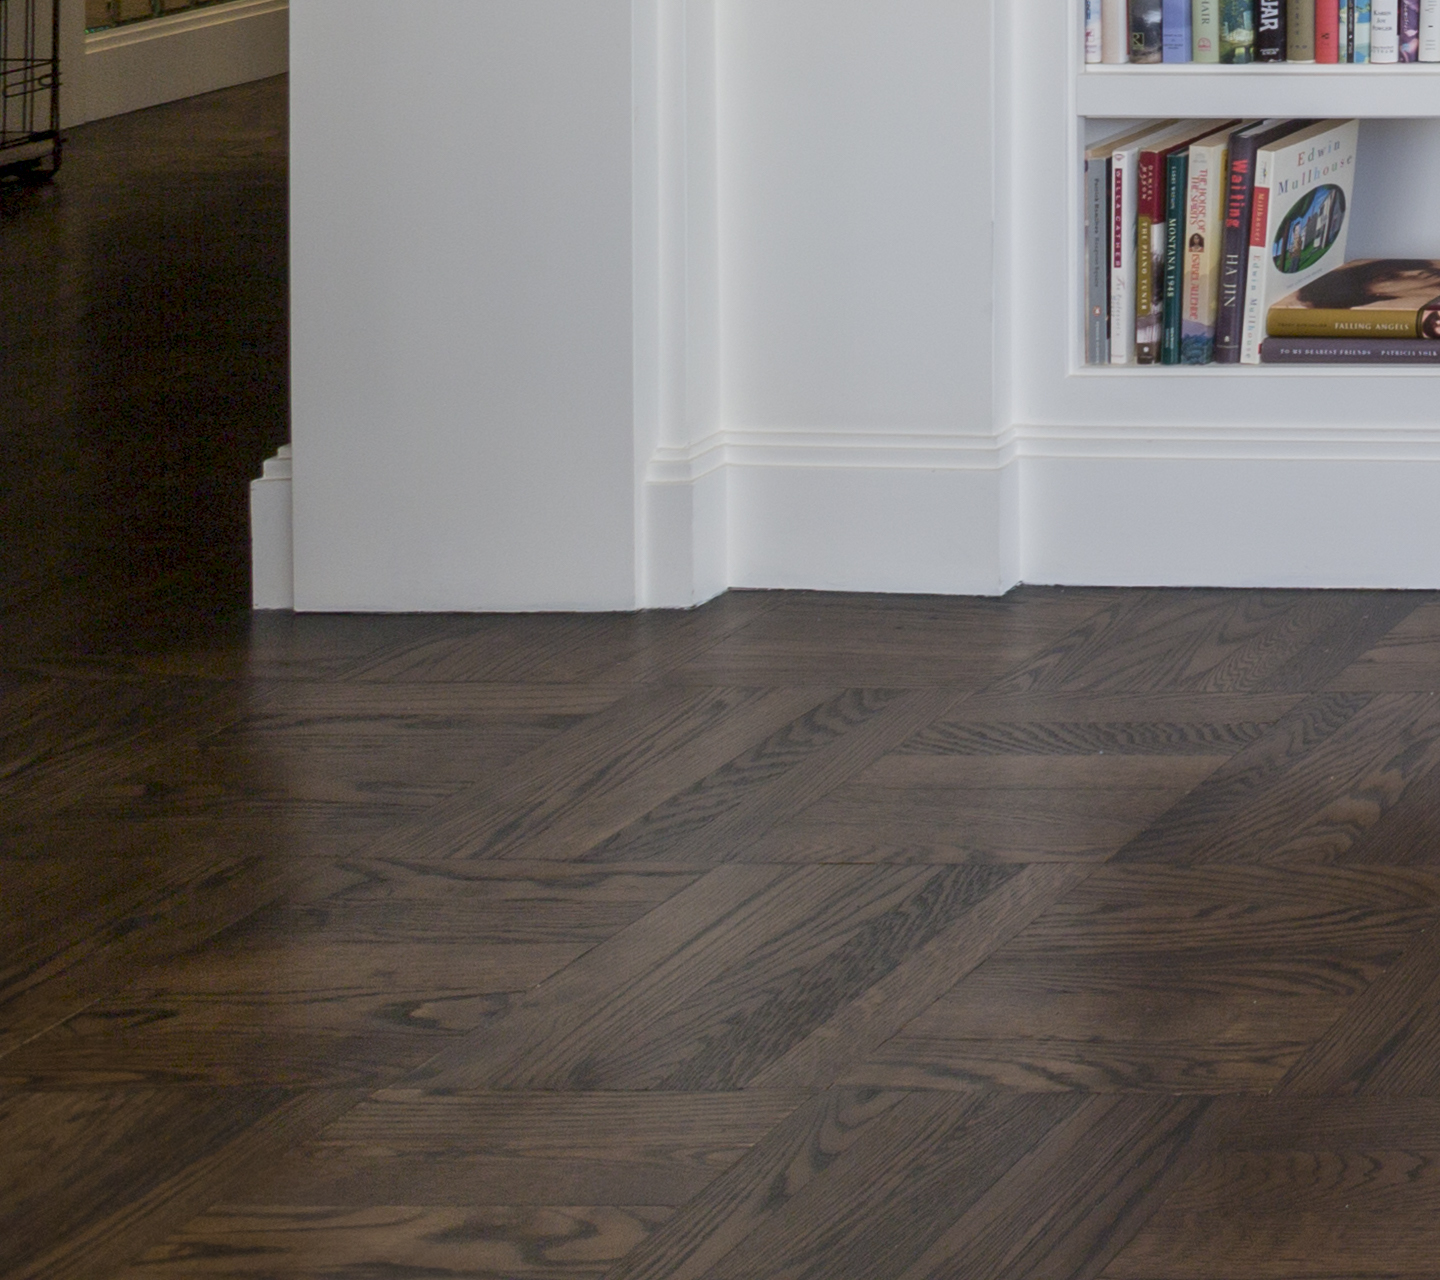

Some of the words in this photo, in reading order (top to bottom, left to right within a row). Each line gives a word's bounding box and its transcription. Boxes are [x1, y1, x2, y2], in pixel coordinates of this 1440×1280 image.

[1227, 160, 1247, 227] Waiting
[1225, 254, 1240, 275] HA
[1224, 283, 1238, 307] JIN
